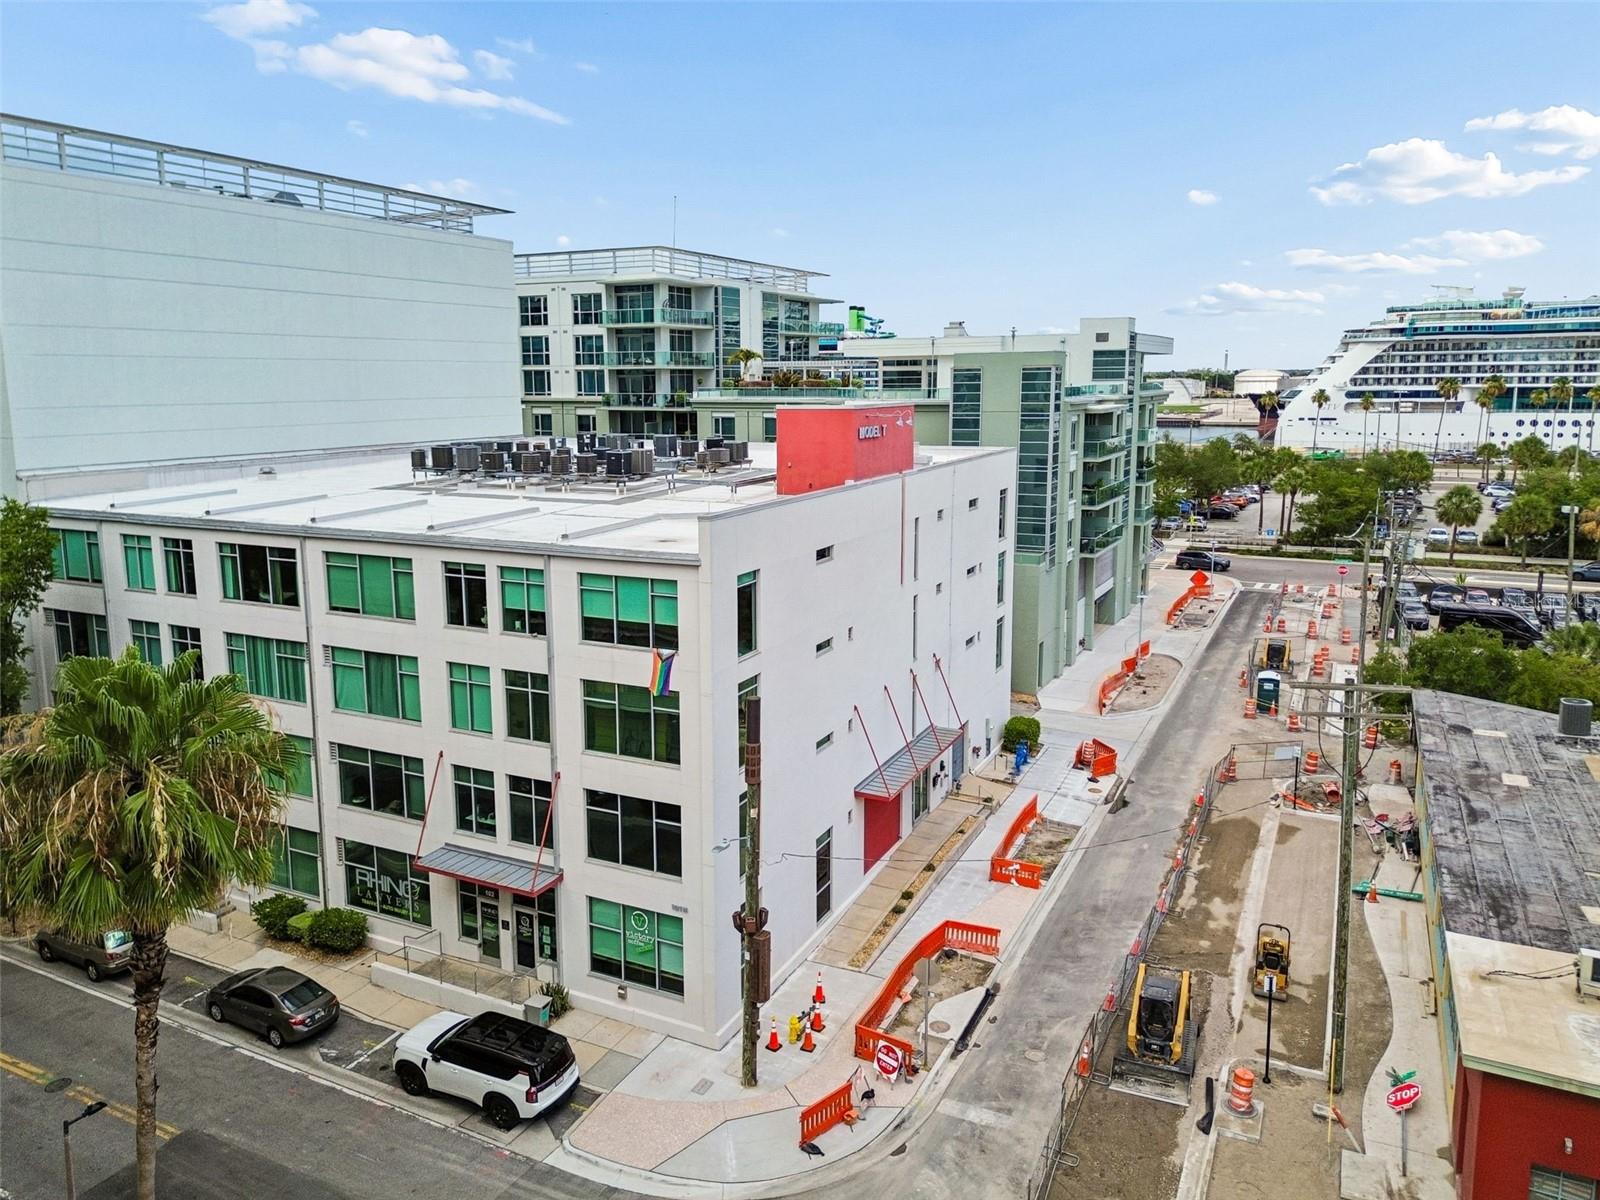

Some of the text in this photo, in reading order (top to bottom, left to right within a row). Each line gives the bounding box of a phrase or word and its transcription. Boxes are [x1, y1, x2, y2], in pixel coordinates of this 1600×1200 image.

[859, 424, 888, 439] MODEL T
[355, 868, 418, 897] RHINO
[357, 886, 420, 911] LAWYERS
[1388, 1087, 1418, 1102] STOP
